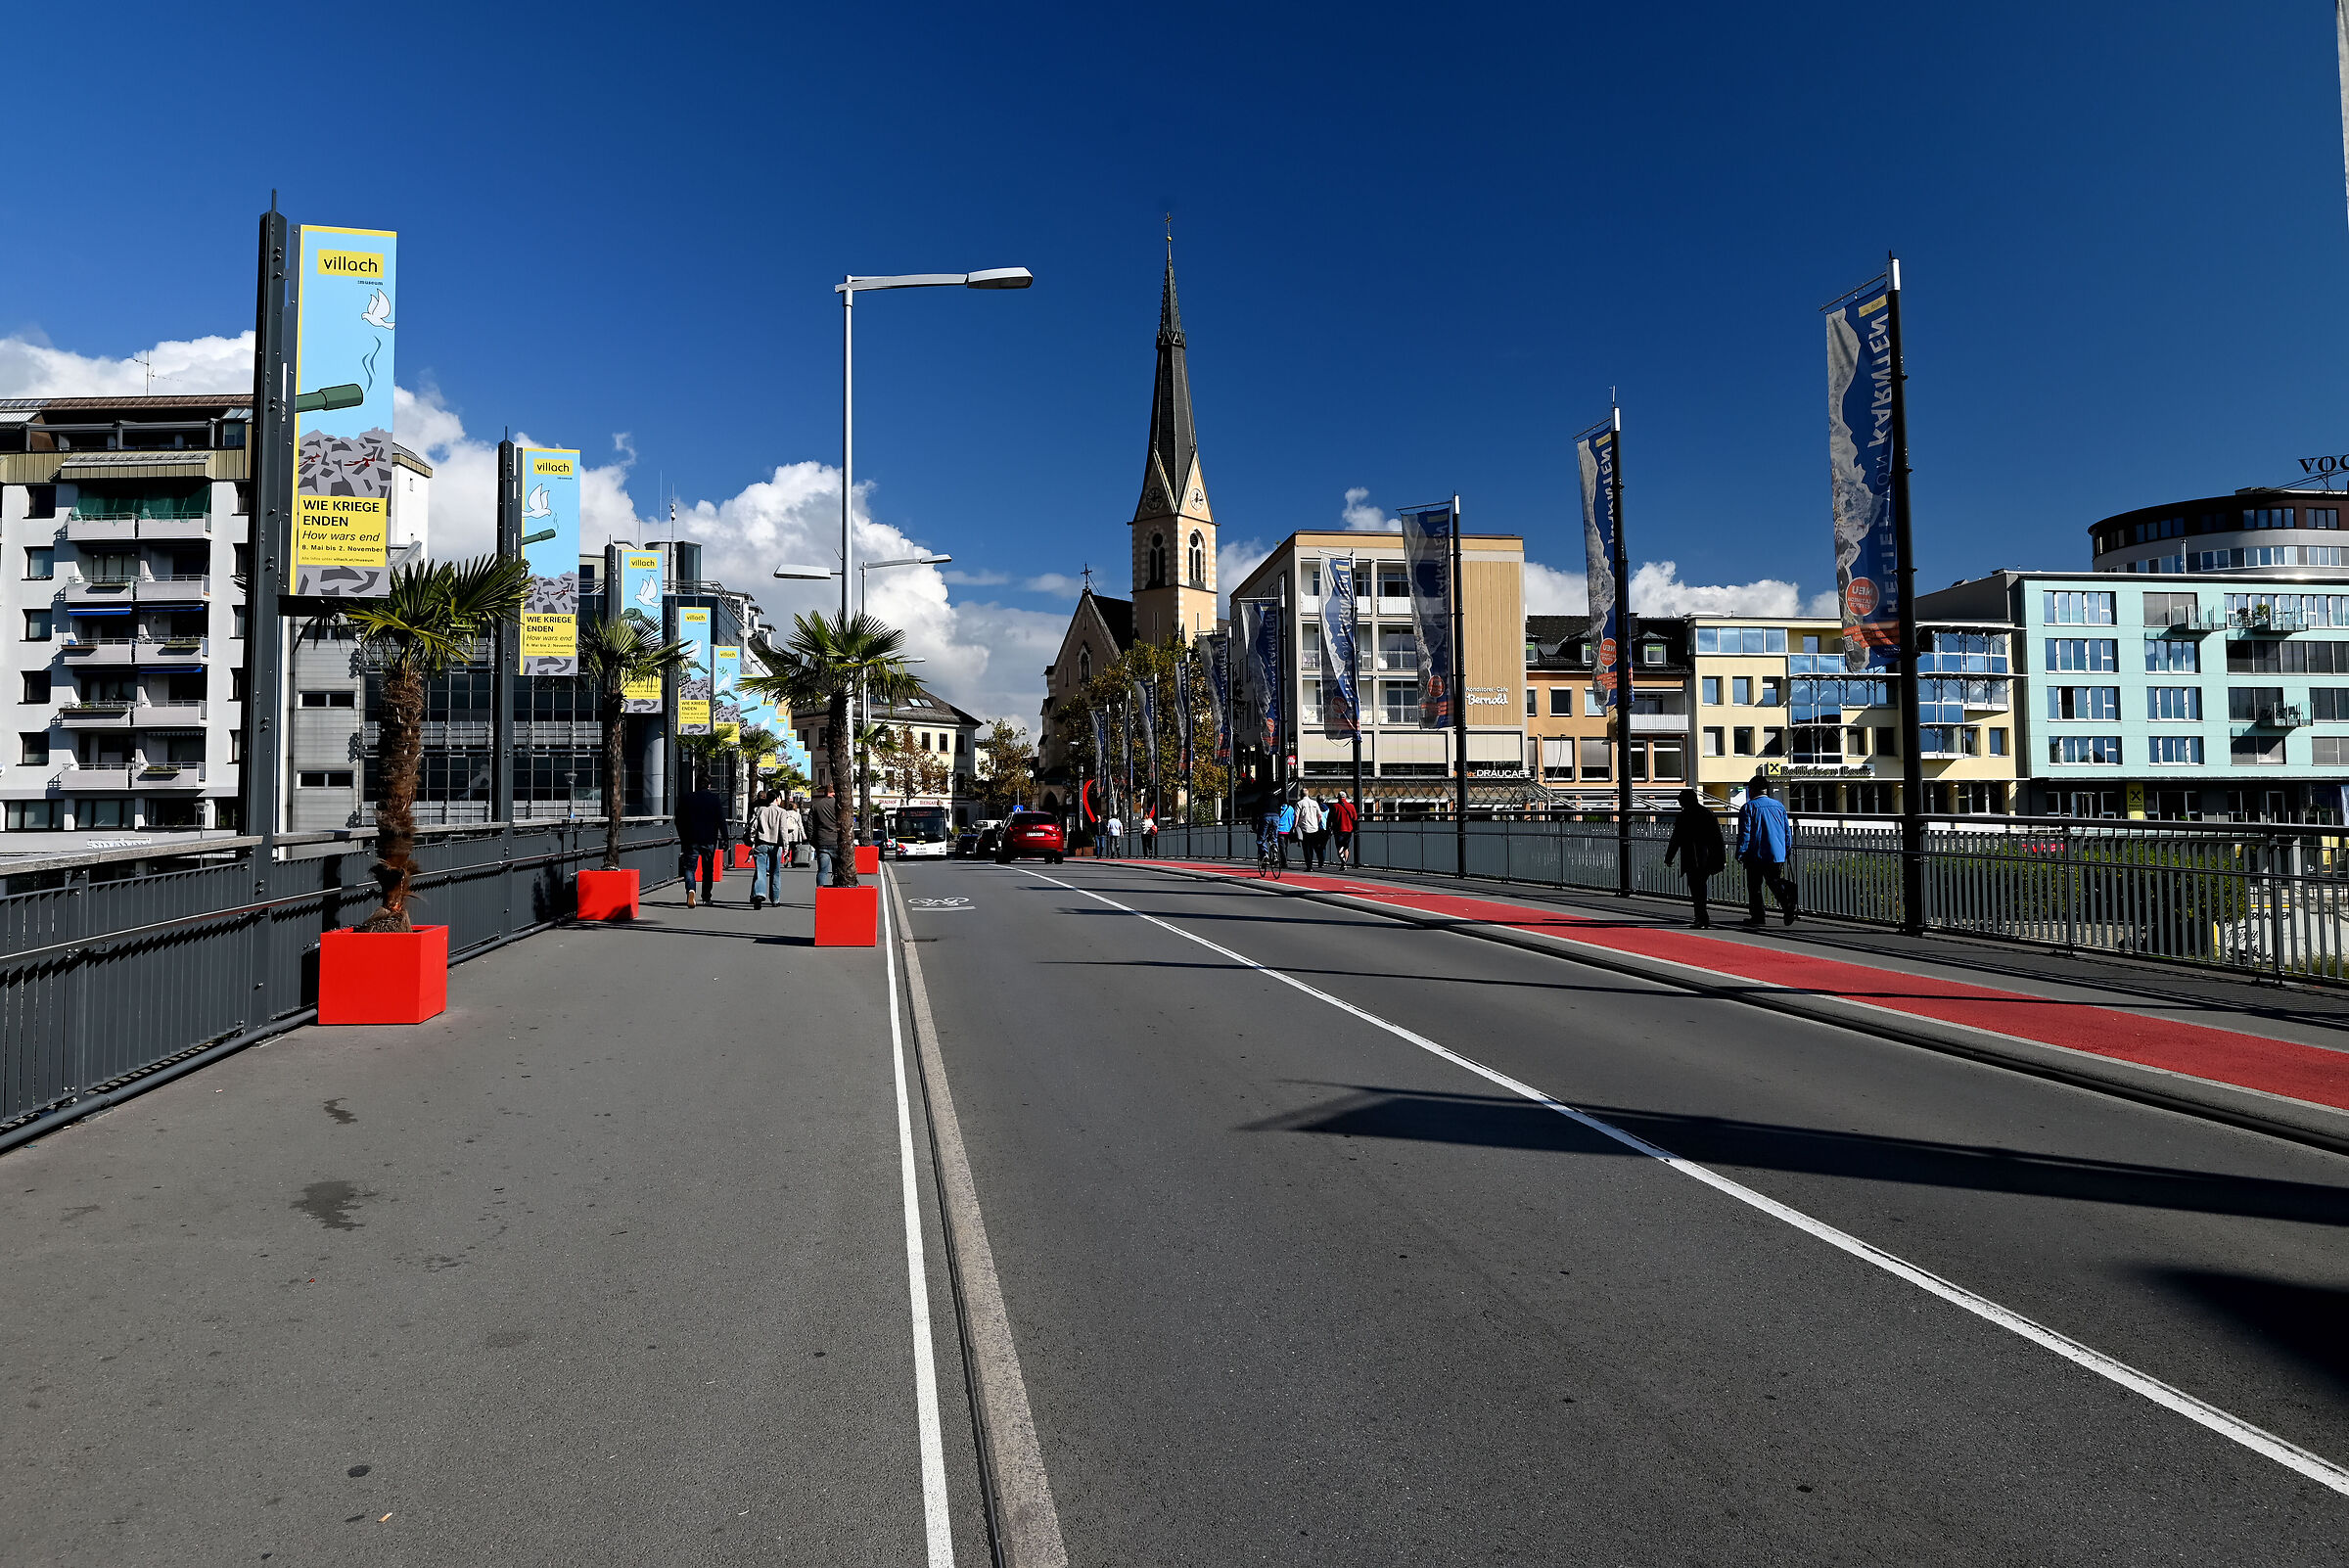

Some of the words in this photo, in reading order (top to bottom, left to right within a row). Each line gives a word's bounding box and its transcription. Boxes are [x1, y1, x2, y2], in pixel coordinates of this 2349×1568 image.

[324, 255, 378, 273] villach
[536, 461, 570, 473] villach
[303, 499, 329, 511] WIE
[333, 500, 380, 513] KRIEGE
[302, 515, 348, 527] ENDEN
[301, 530, 328, 540] How
[330, 532, 356, 541] wars
[359, 532, 381, 542] end
[1466, 693, 1509, 706] Bernold
[1476, 769, 1532, 778] DRAUCAFE
